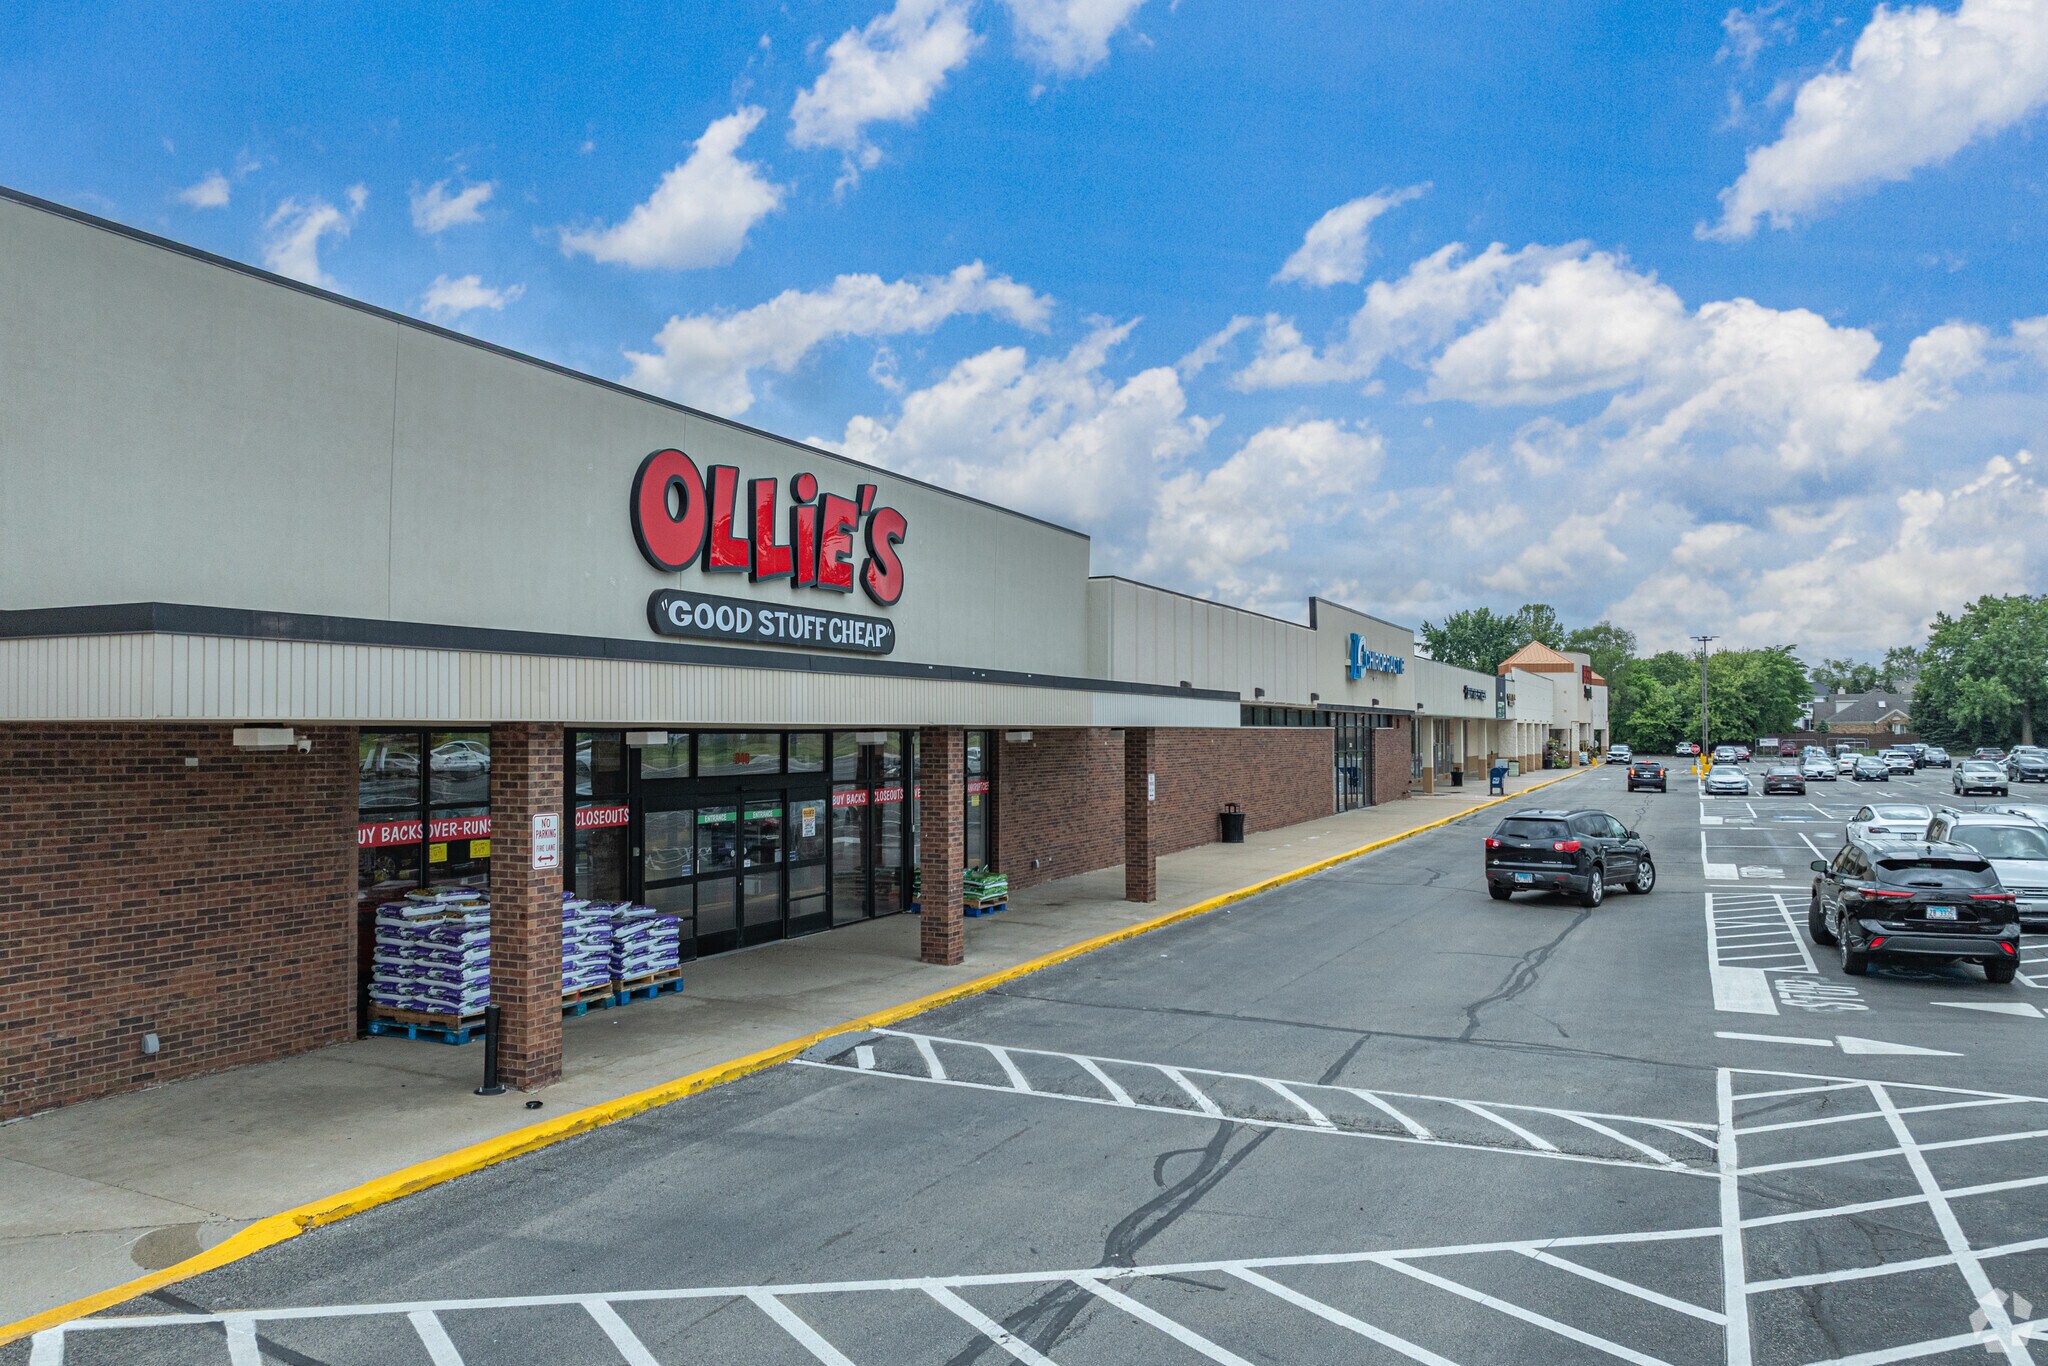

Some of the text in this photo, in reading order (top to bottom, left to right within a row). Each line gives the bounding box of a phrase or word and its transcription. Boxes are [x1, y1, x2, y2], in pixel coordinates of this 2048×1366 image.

[758, 610, 827, 641] STUFF
[833, 793, 866, 806] BUY BACKS
[575, 807, 629, 827] CLOSEOUTS
[704, 813, 727, 823] ENTRANCE
[753, 810, 773, 819] ENTRANCE
[541, 818, 551, 829] NO
[357, 823, 423, 844] UY BACKS
[535, 828, 556, 840] PARKING
